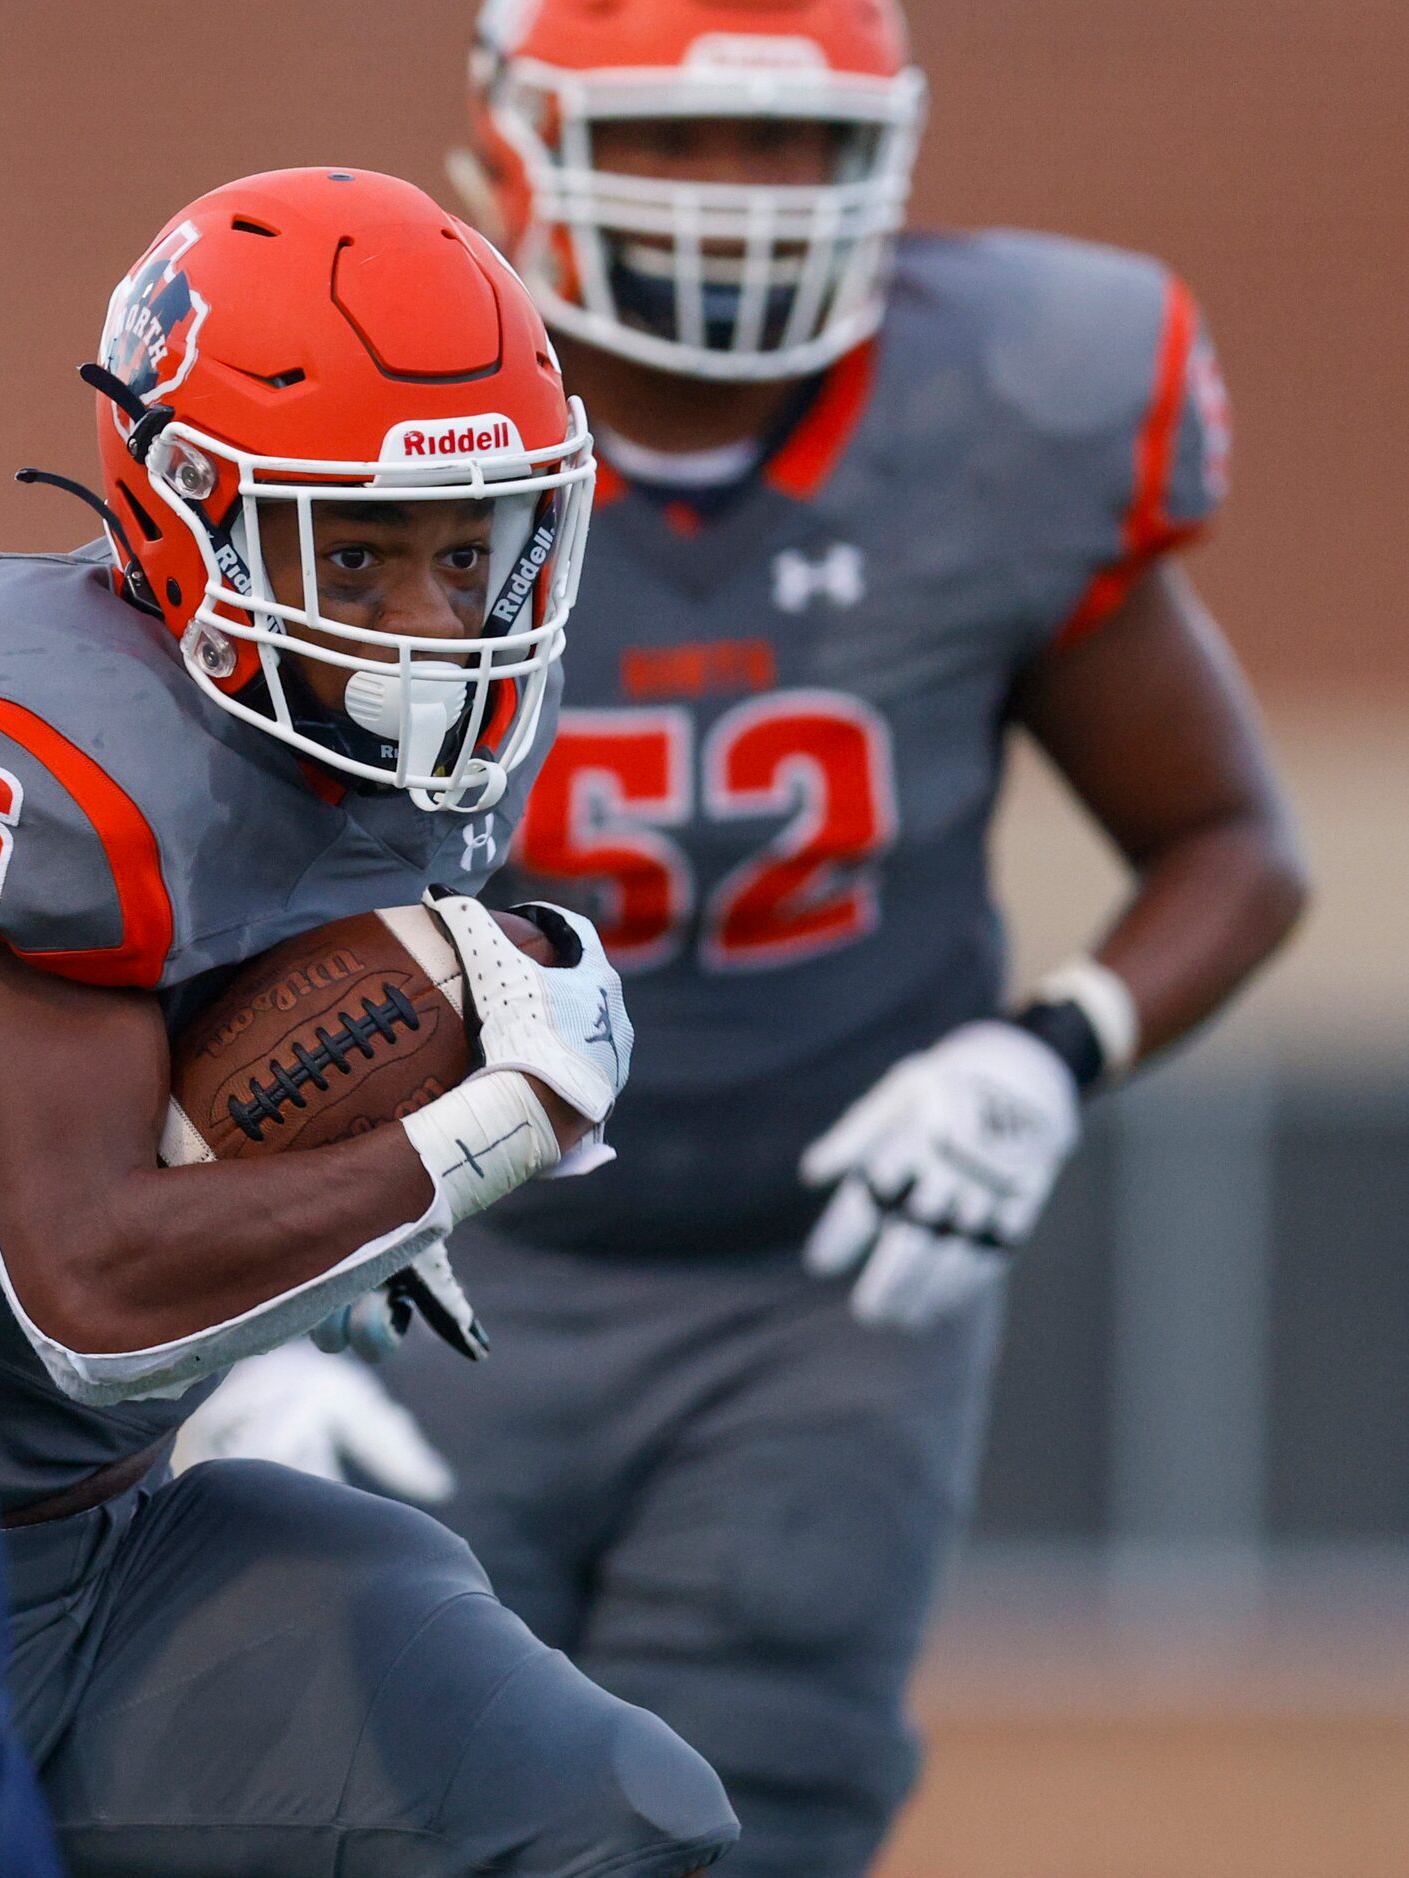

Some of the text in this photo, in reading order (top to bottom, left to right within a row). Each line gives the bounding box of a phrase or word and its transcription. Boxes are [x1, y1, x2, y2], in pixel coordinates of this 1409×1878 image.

[403, 422, 509, 456] Riddell
[492, 527, 554, 623] Riddell
[517, 690, 895, 972] 52
[196, 948, 365, 1059] Wilson
